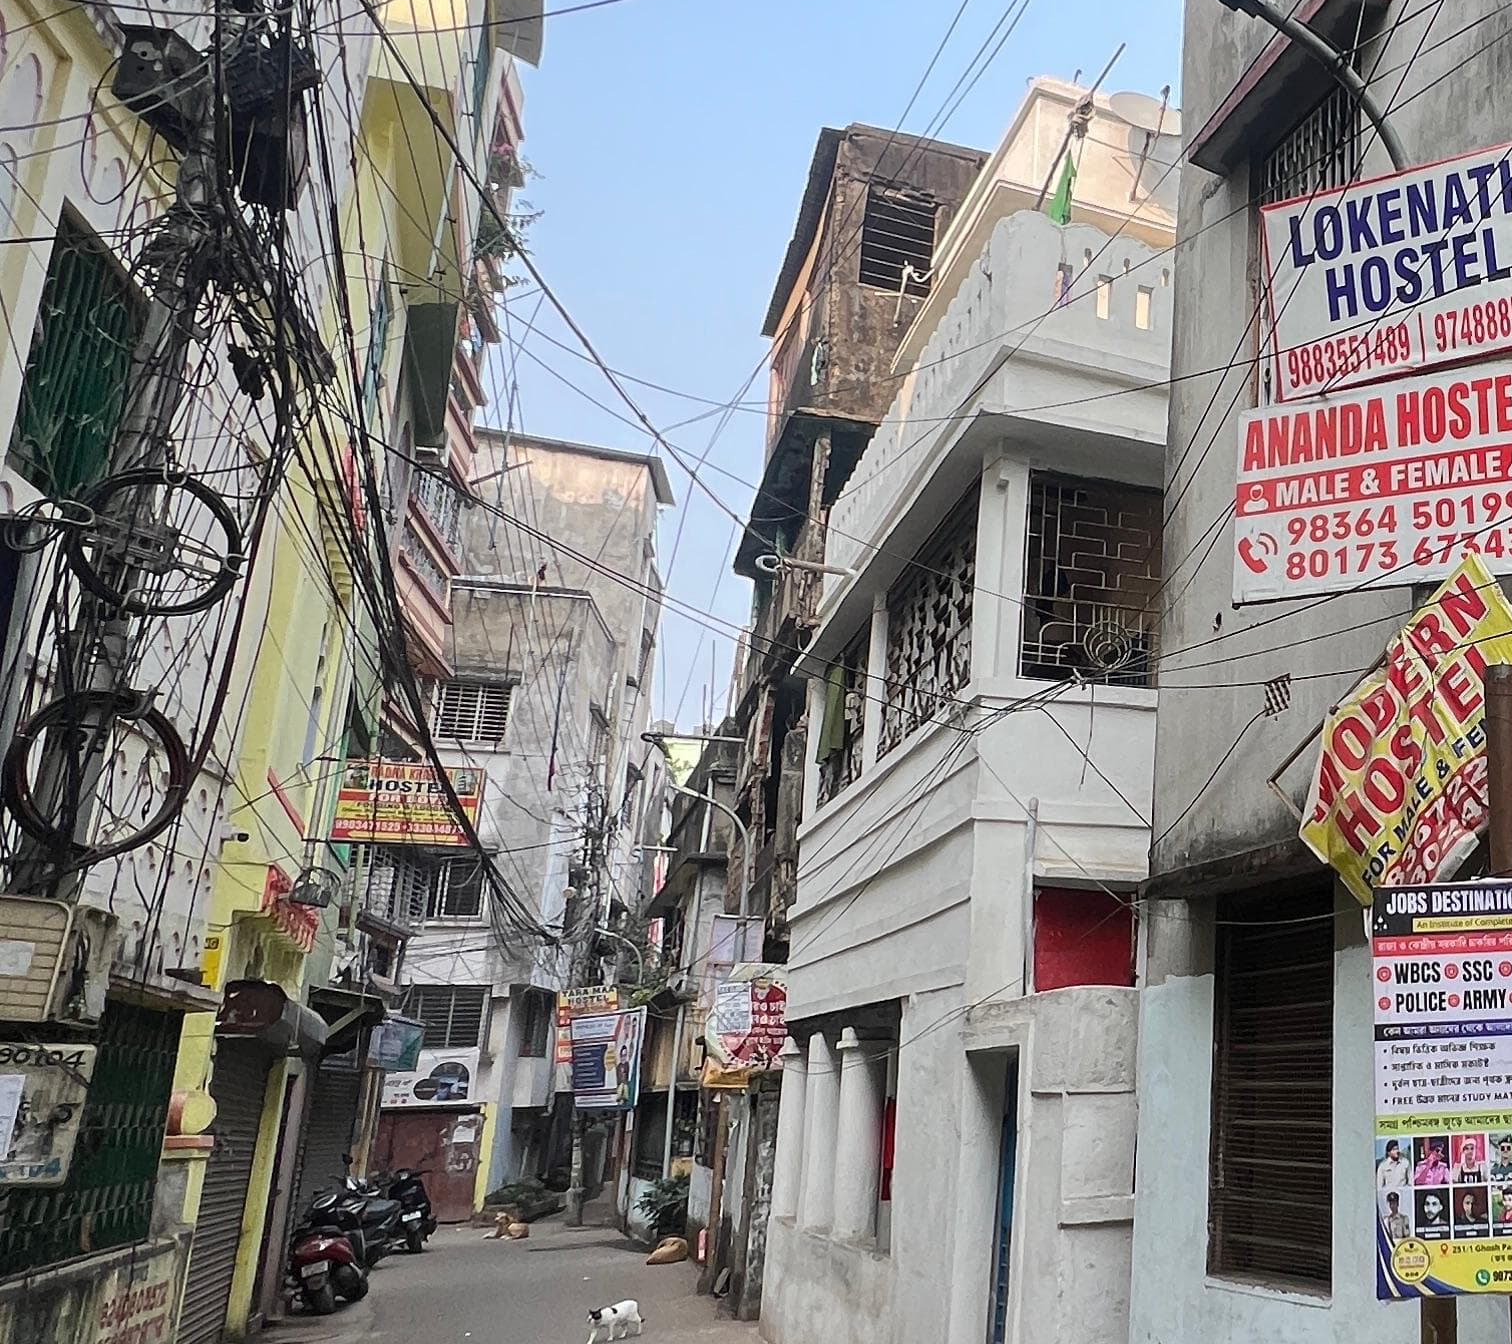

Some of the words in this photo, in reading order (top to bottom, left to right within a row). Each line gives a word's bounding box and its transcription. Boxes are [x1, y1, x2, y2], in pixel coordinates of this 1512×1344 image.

[1326, 228, 1511, 322] HOSTEL
[1286, 321, 1411, 388] 9883551489
[1243, 397, 1388, 472] ANANDA
[1275, 471, 1350, 508] MALE
[1360, 467, 1381, 497] &
[1390, 451, 1502, 492] FEMALE
[1287, 504, 1398, 547] 98364
[1285, 540, 1398, 581] 80173
[1311, 573, 1490, 823] MODERN
[1362, 841, 1396, 889] FOR
[1393, 776, 1433, 843] MALE
[1436, 759, 1450, 778] &
[1386, 892, 1427, 915] JOBS
[1416, 919, 1428, 929] An
[1429, 917, 1463, 928] Institute
[1465, 917, 1473, 926] of
[1394, 962, 1441, 984] WBCS
[1462, 960, 1493, 982] SSC
[1396, 991, 1447, 1013] POLICE
[1463, 989, 1507, 1010] ARMY
[1392, 1096, 1413, 1106] FREE
[1462, 1092, 1492, 1102] STUDY
